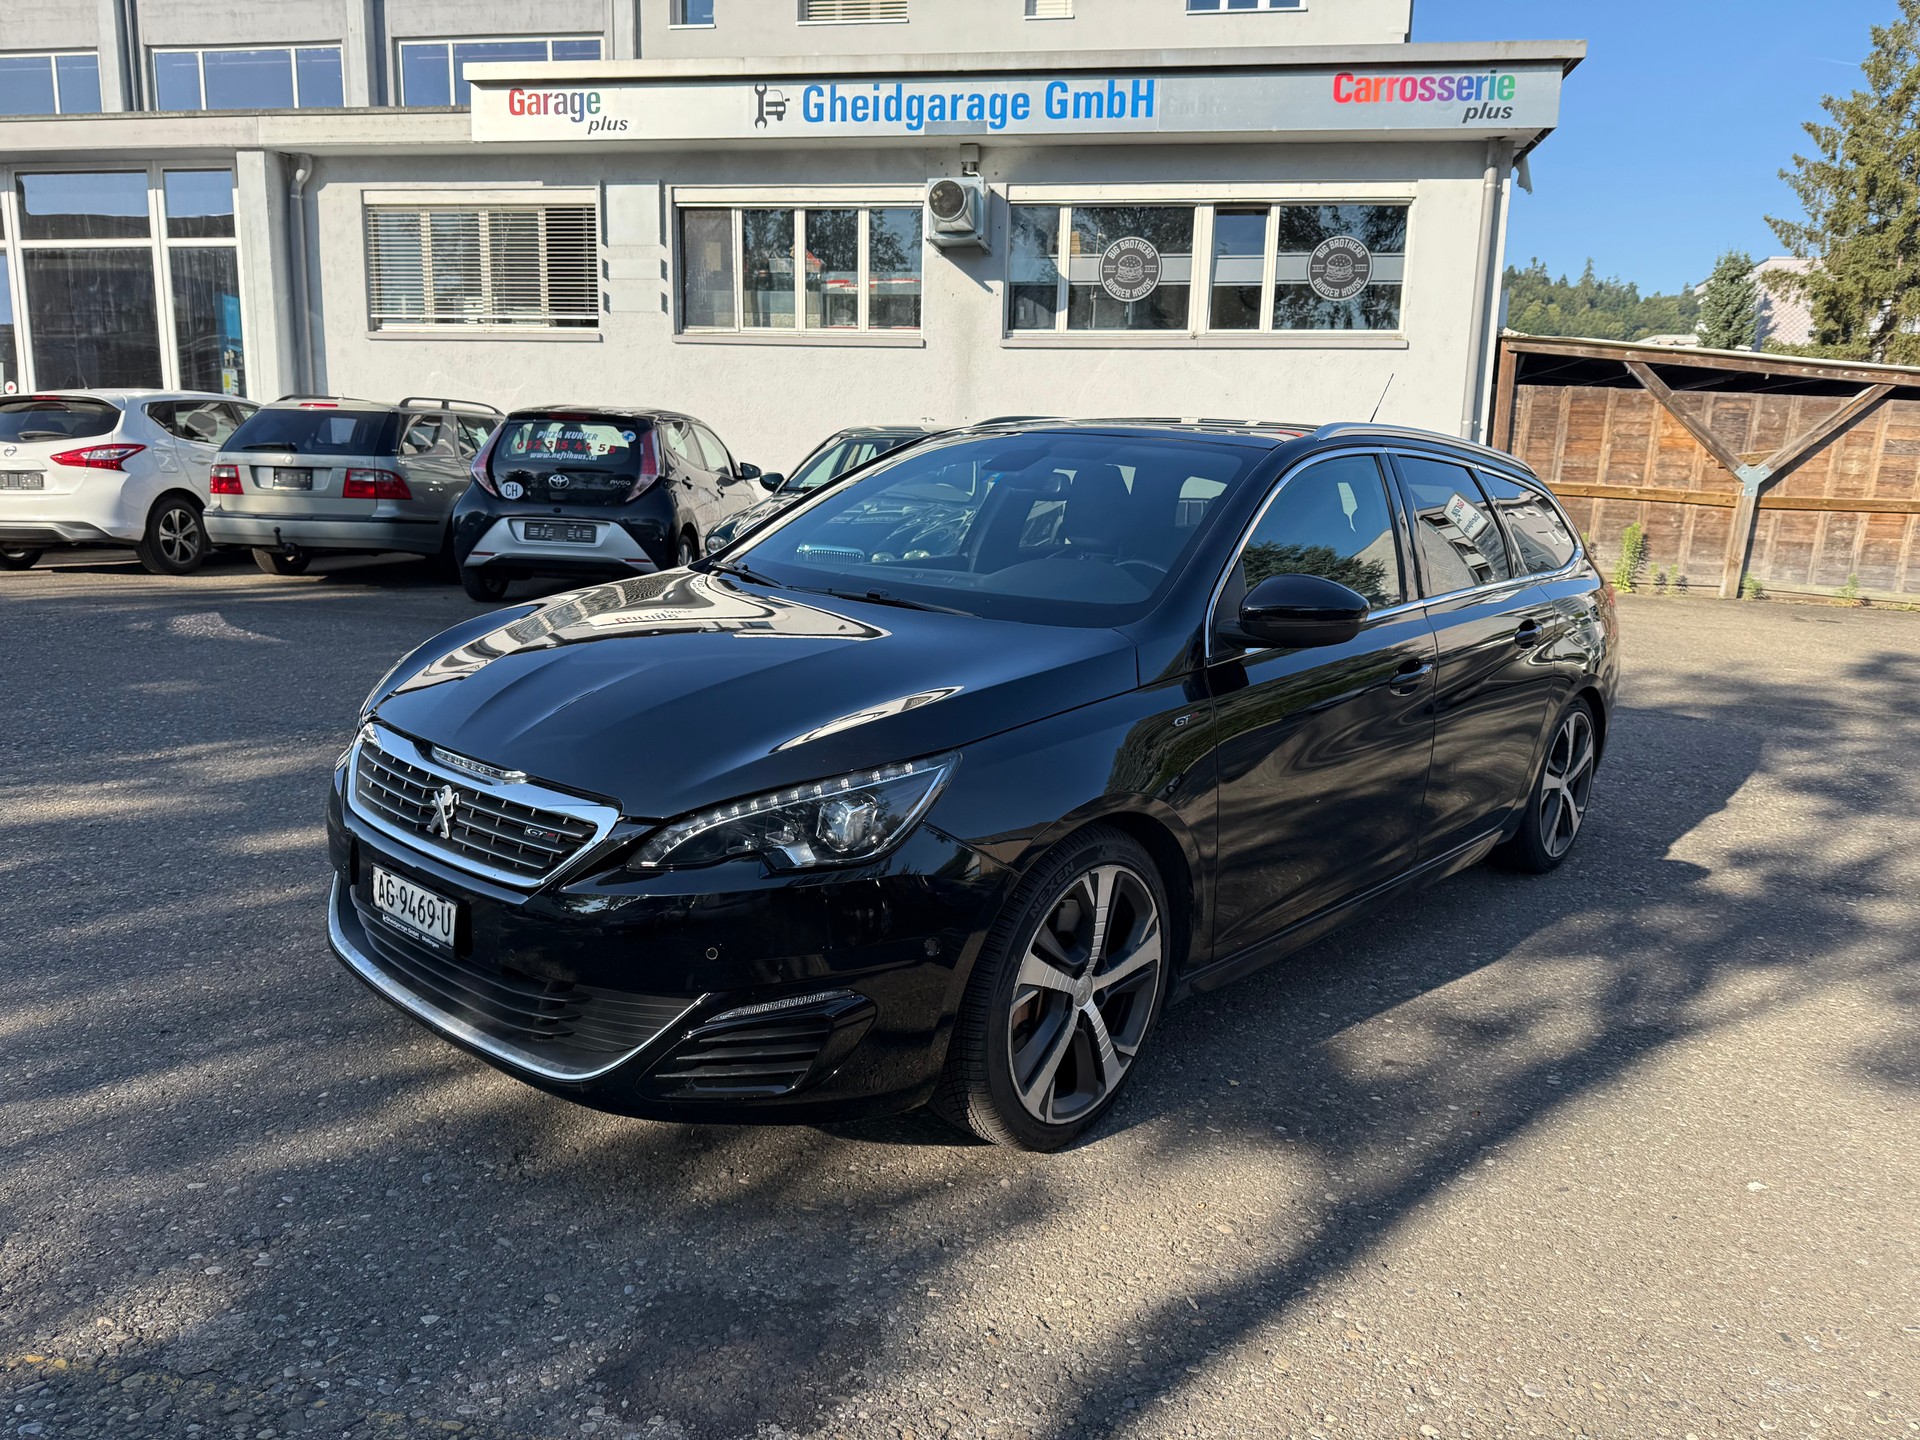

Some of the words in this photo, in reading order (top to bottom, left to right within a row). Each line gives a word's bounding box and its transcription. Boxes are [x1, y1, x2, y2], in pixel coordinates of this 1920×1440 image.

[1333, 70, 1516, 104] Carrosserie
[508, 88, 601, 123] Garage
[803, 83, 1031, 131] Gheidgarage
[1045, 79, 1155, 119] GmbH
[1461, 102, 1514, 124] plus
[587, 116, 629, 135] plus
[1107, 245, 1121, 260] BIG
[1119, 240, 1155, 260] BROTHERS
[1316, 245, 1330, 259] BIG
[1328, 238, 1366, 259] BROTHERS
[1105, 277, 1131, 298] BURGER
[1131, 277, 1155, 298] HOUSE
[1313, 277, 1340, 298] BURGER
[1341, 276, 1365, 297] HOUSE
[536, 430, 563, 440] PIZZA
[564, 431, 599, 441] KURIER
[505, 484, 518, 497] CH
[1029, 861, 1076, 919] NEXEN
